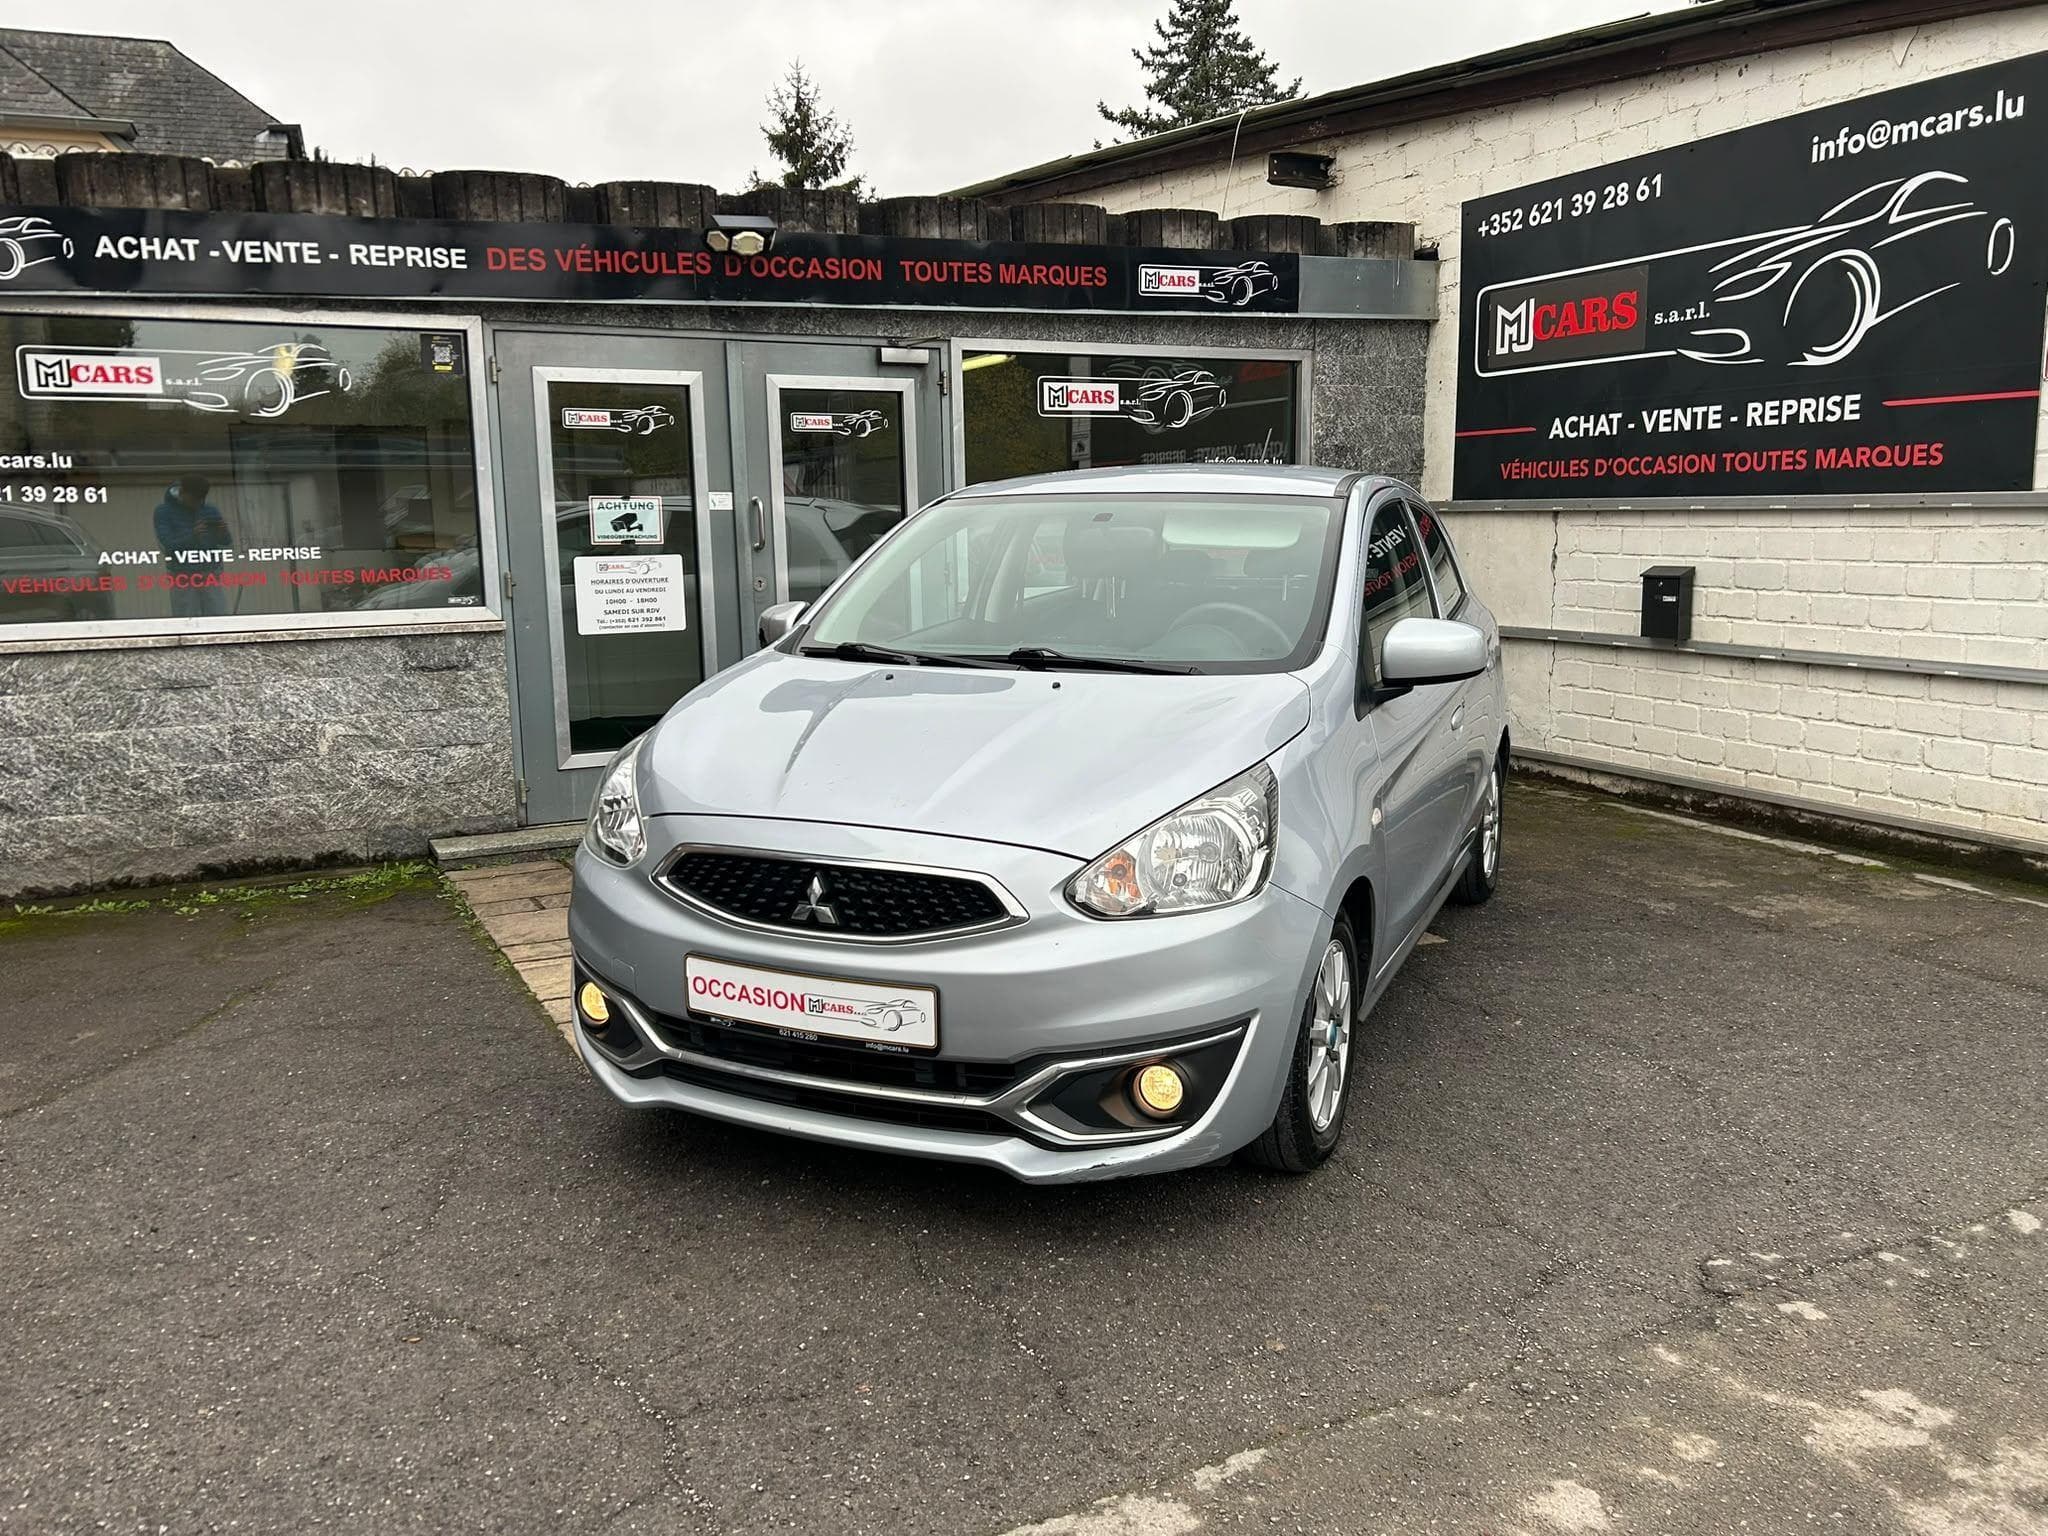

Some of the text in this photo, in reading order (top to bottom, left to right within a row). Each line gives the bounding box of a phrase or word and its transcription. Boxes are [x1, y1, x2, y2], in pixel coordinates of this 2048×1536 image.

[1811, 89, 2025, 164] info@mcars.lu
[1477, 173, 1662, 238] +352 621 39 28 61
[95, 235, 200, 262] ACHAT
[349, 244, 468, 270] REPRISE
[486, 246, 547, 272] DES
[554, 243, 712, 275] VÉHICULES
[724, 255, 883, 281] D'OCCASION
[900, 260, 993, 284] TOUTES
[1000, 263, 1108, 288] MARQUES
[1653, 301, 1711, 325] s.a.r.l.
[1548, 412, 1623, 440] ACHAT
[1641, 405, 1723, 434] VENTE
[1746, 393, 1862, 428] REPRISE
[1500, 442, 1945, 480] VÉHICULES D'OCCASION TOUTES MARQUES
[0, 485, 108, 504] 1 39 28 61
[597, 501, 655, 511] ACHTUNG
[98, 550, 161, 565] ACHAT
[174, 549, 234, 564] VENTE
[248, 546, 322, 562] REPRISE
[2, 576, 128, 594] VÉHICULES
[280, 569, 355, 586] TOUTES
[361, 567, 452, 584] MARQUES
[590, 578, 624, 586] HORAIRES
[603, 608, 630, 616] SAMEDI
[692, 975, 806, 1013] OCCASION
[778, 1028, 791, 1038] 621
